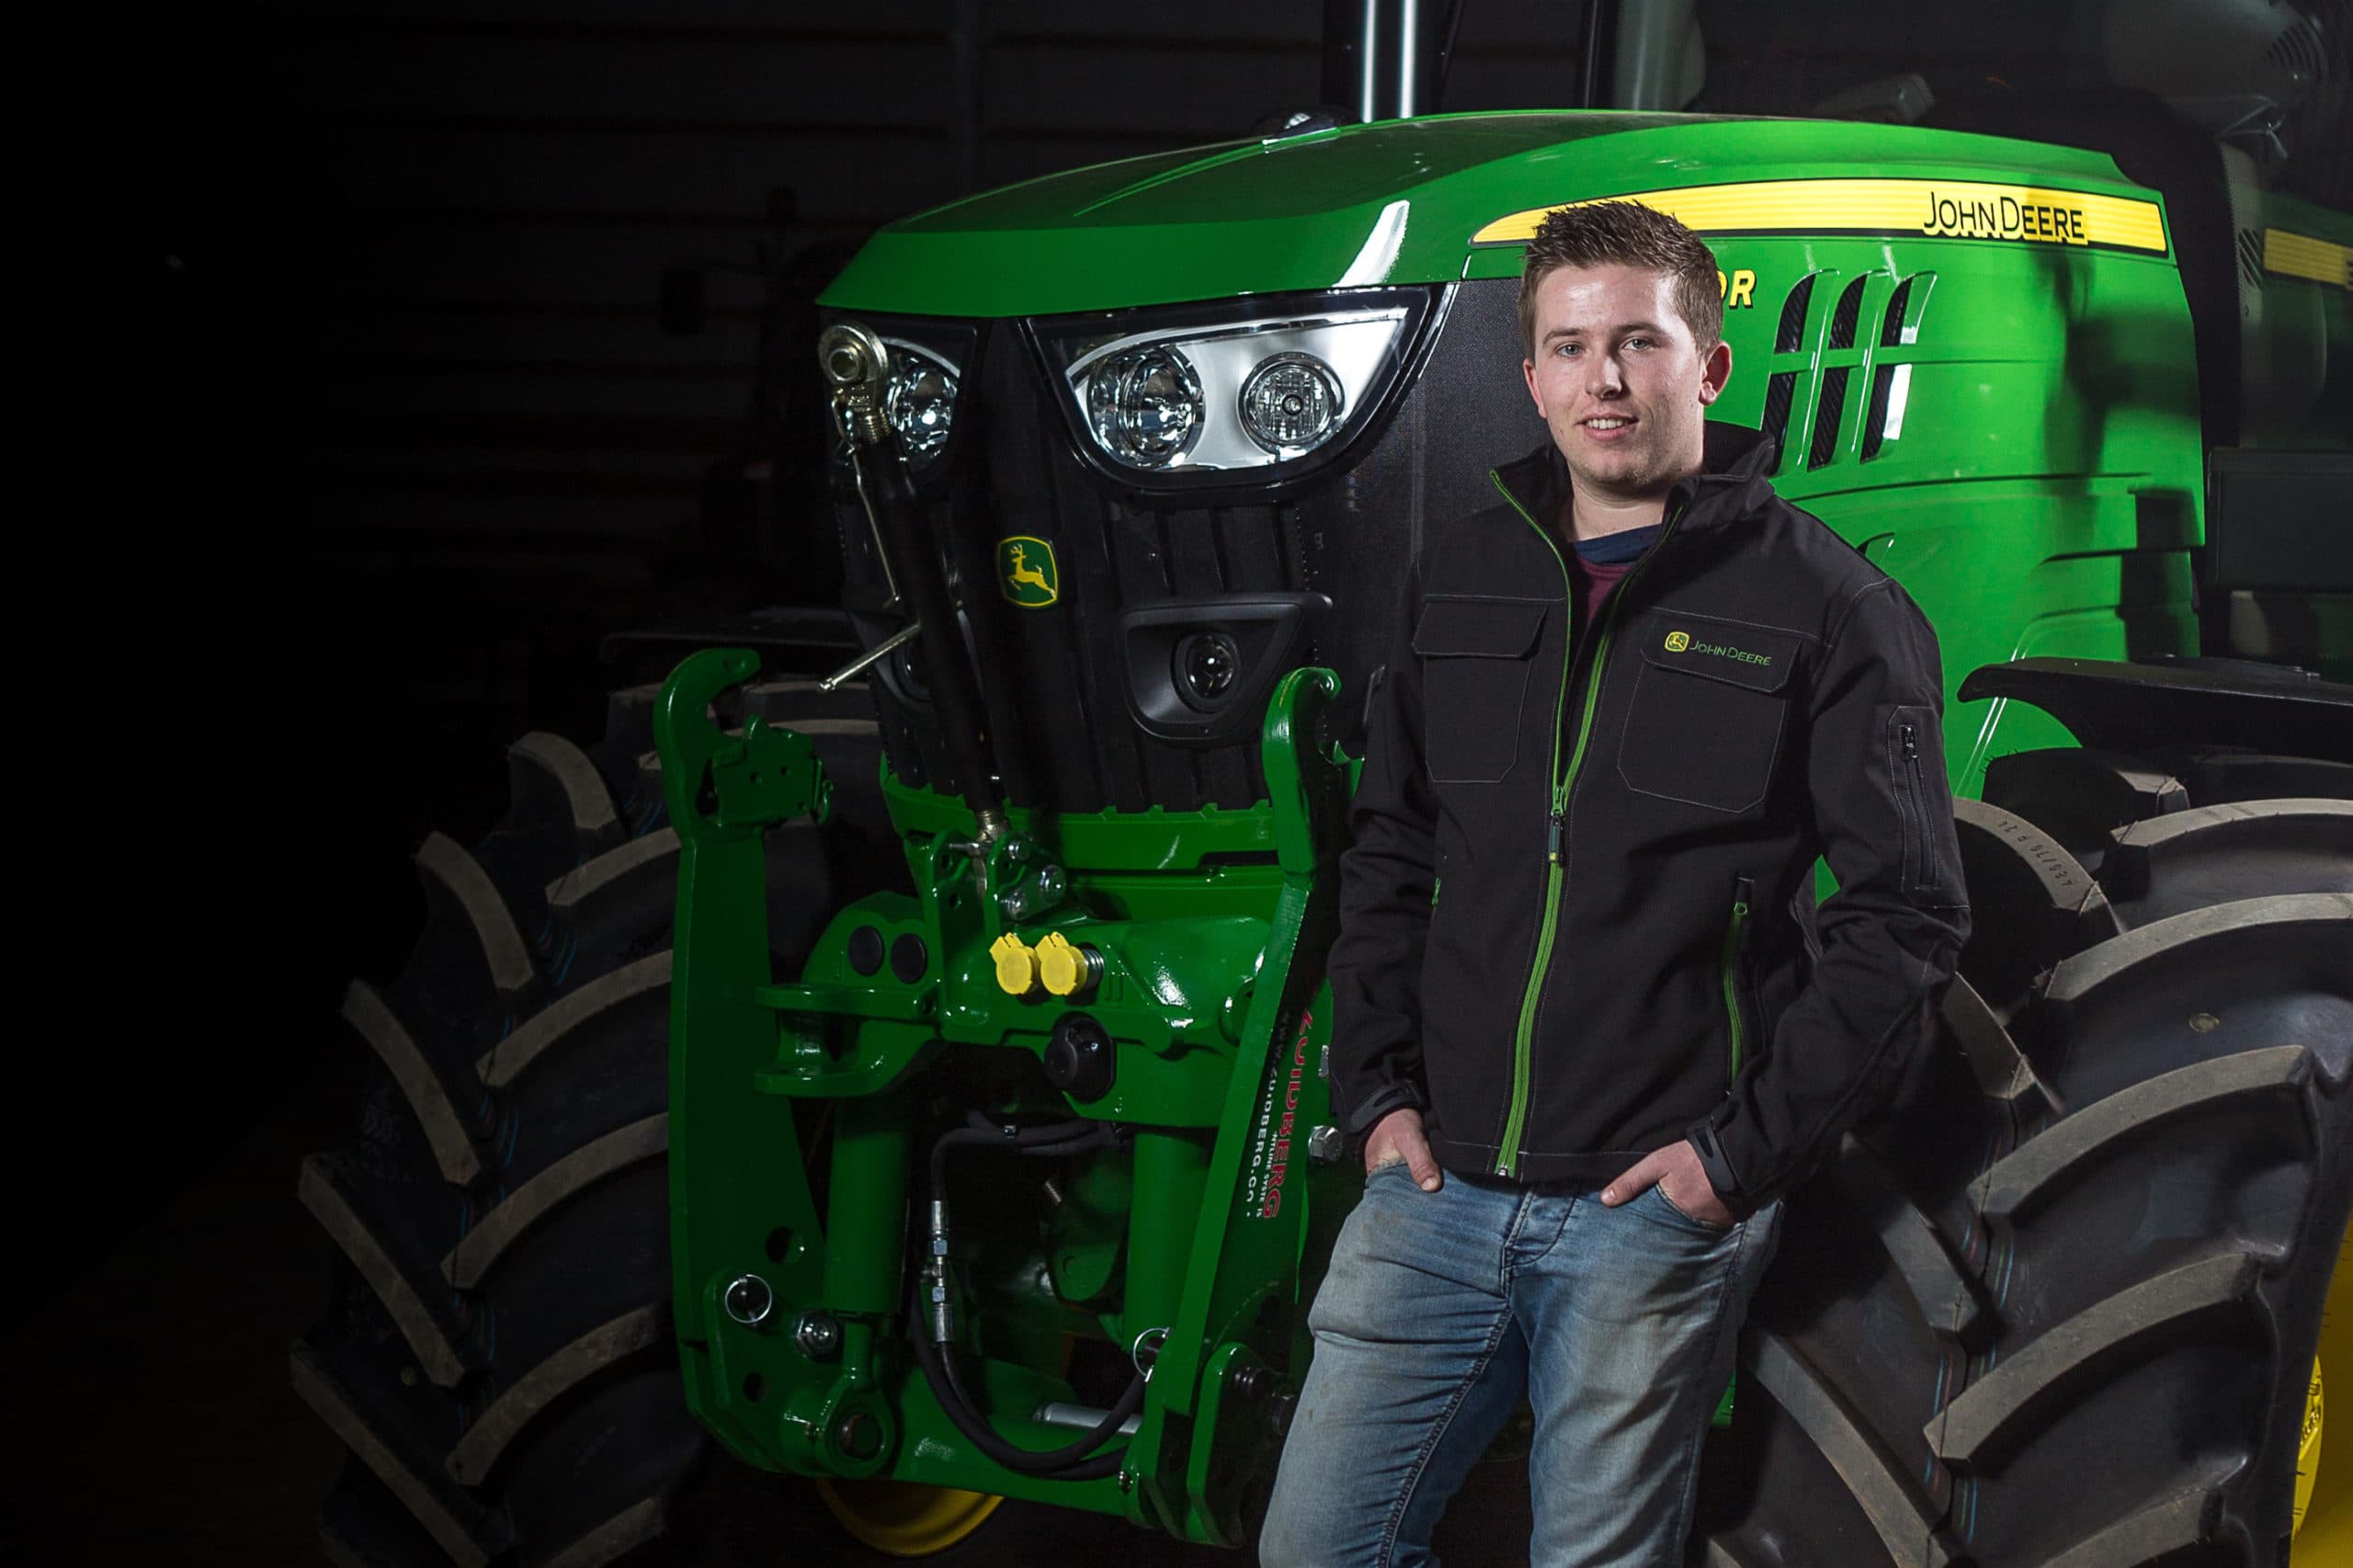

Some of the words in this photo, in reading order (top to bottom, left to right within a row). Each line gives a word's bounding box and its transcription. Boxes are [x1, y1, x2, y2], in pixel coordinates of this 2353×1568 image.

[1924, 191, 1995, 231] JOHN
[2000, 196, 2085, 238] DEERE
[1689, 641, 1725, 656] JOHN
[1727, 647, 1772, 665] DEERE
